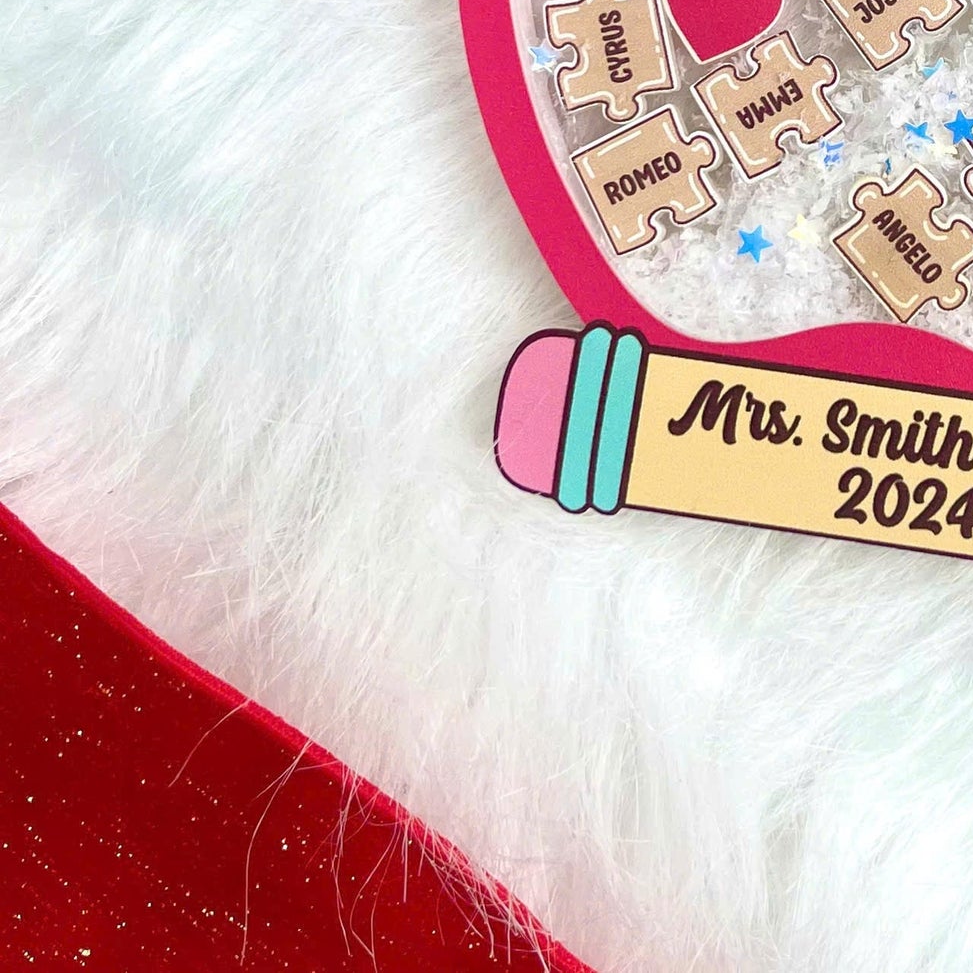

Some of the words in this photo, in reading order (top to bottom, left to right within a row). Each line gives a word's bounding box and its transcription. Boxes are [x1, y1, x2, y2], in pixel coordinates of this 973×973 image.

[599, 9, 632, 84] CYRUS
[737, 79, 803, 129] EMMA
[604, 152, 681, 204] ROMEO
[872, 210, 942, 283] ANGELO
[668, 380, 802, 446] Mrs.
